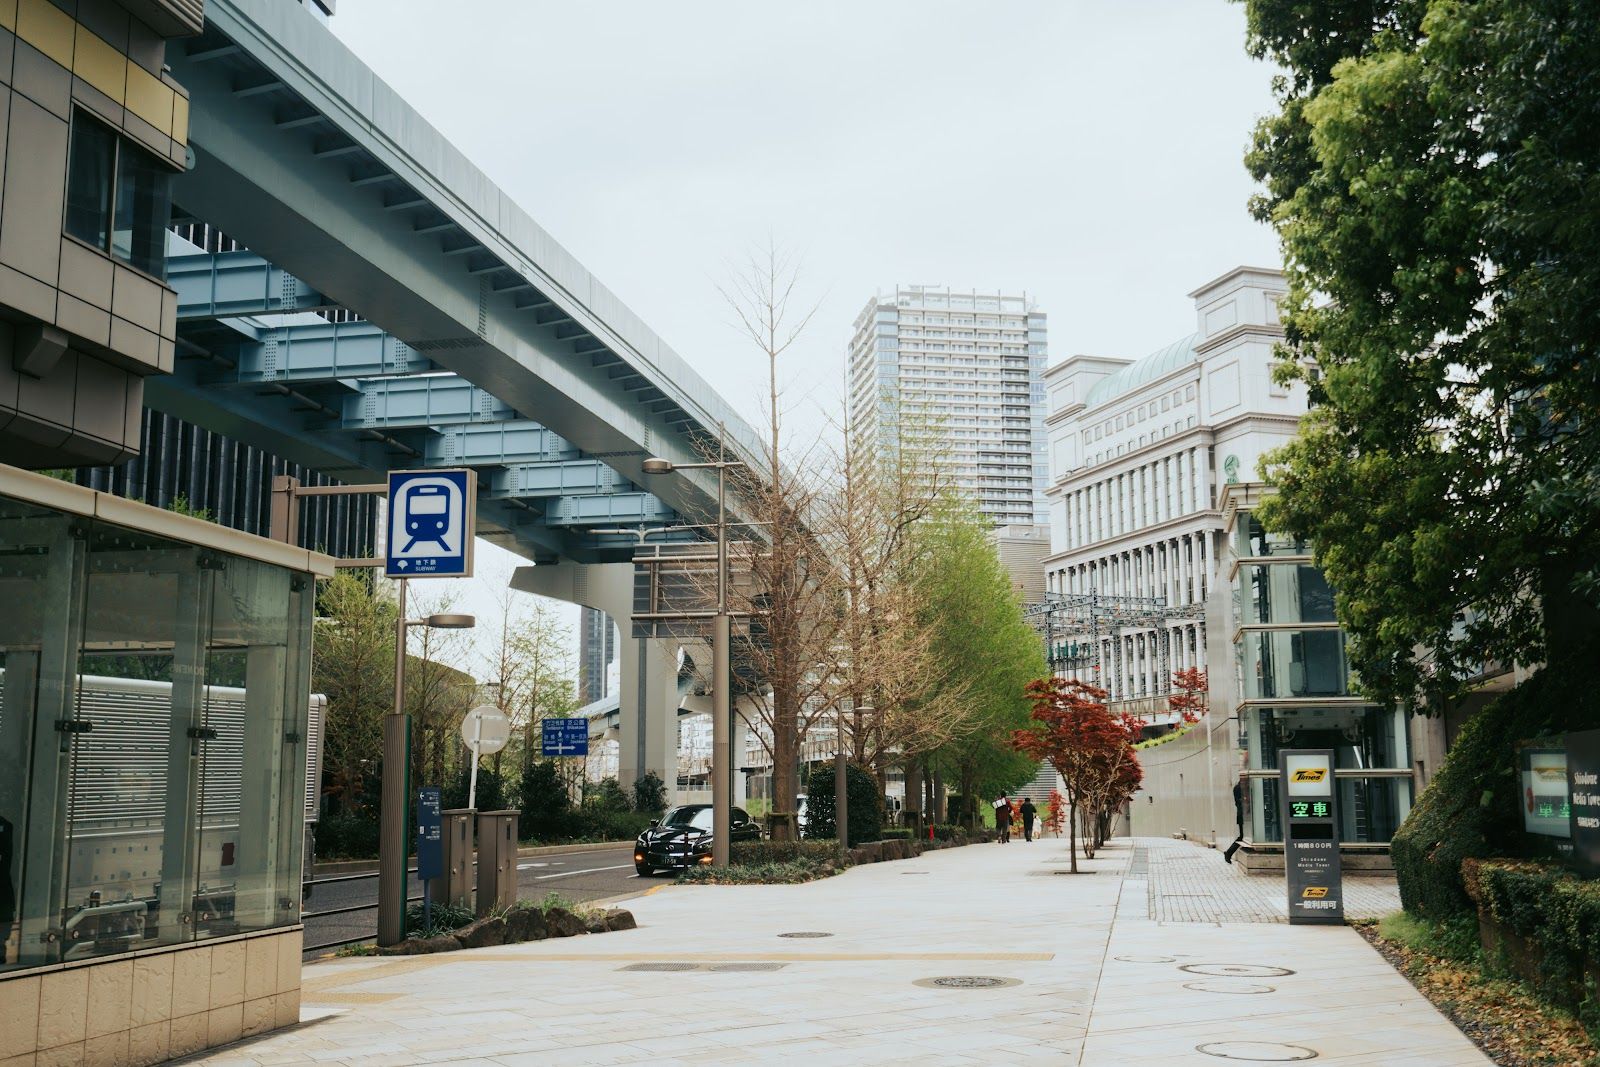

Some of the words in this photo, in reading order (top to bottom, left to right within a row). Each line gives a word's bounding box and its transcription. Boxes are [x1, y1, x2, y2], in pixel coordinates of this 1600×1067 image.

[1295, 770, 1325, 781] Times
[1292, 801, 1329, 817] 空車
[1295, 900, 1337, 910] 一般利用可
